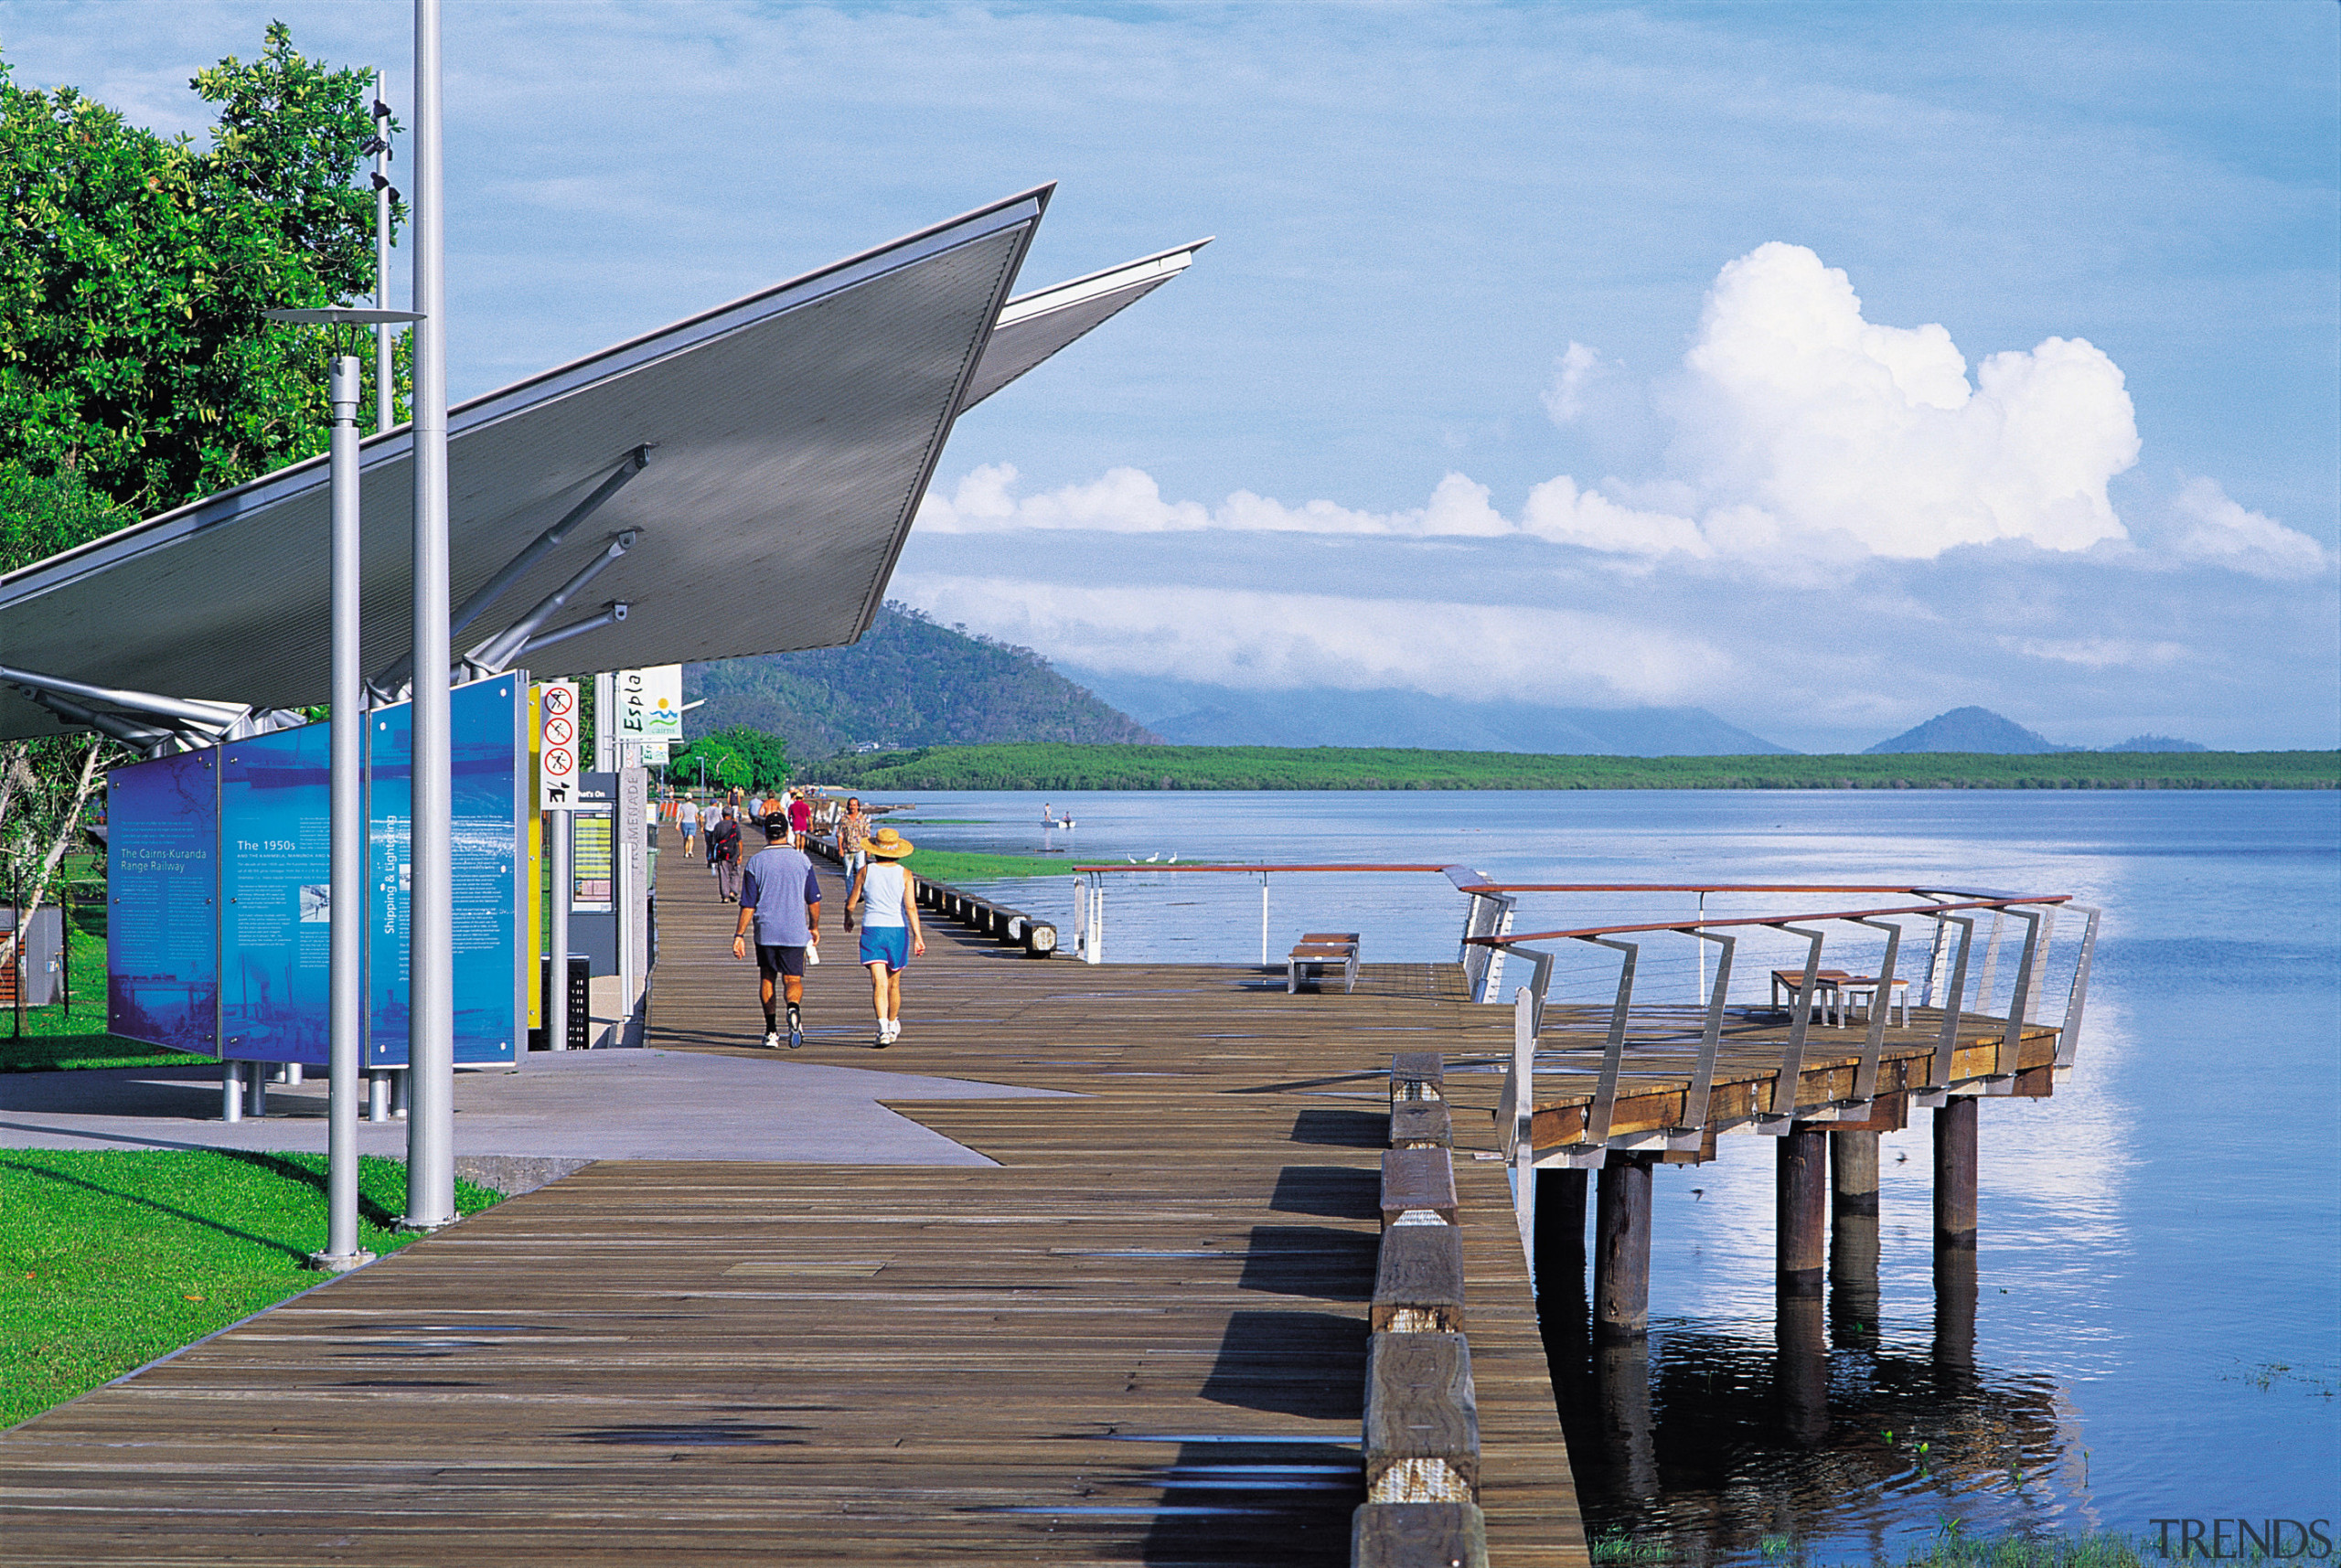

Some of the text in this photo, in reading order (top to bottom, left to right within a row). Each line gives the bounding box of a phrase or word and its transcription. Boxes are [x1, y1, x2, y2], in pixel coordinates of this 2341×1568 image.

[624, 675, 644, 732] Espla
[578, 790, 605, 798] hat's On
[237, 840, 295, 850] The 1950s
[121, 848, 207, 859] The Cairns-Kuranda
[121, 860, 185, 873] Range Railway
[384, 815, 397, 934] Shipping & Lightering
